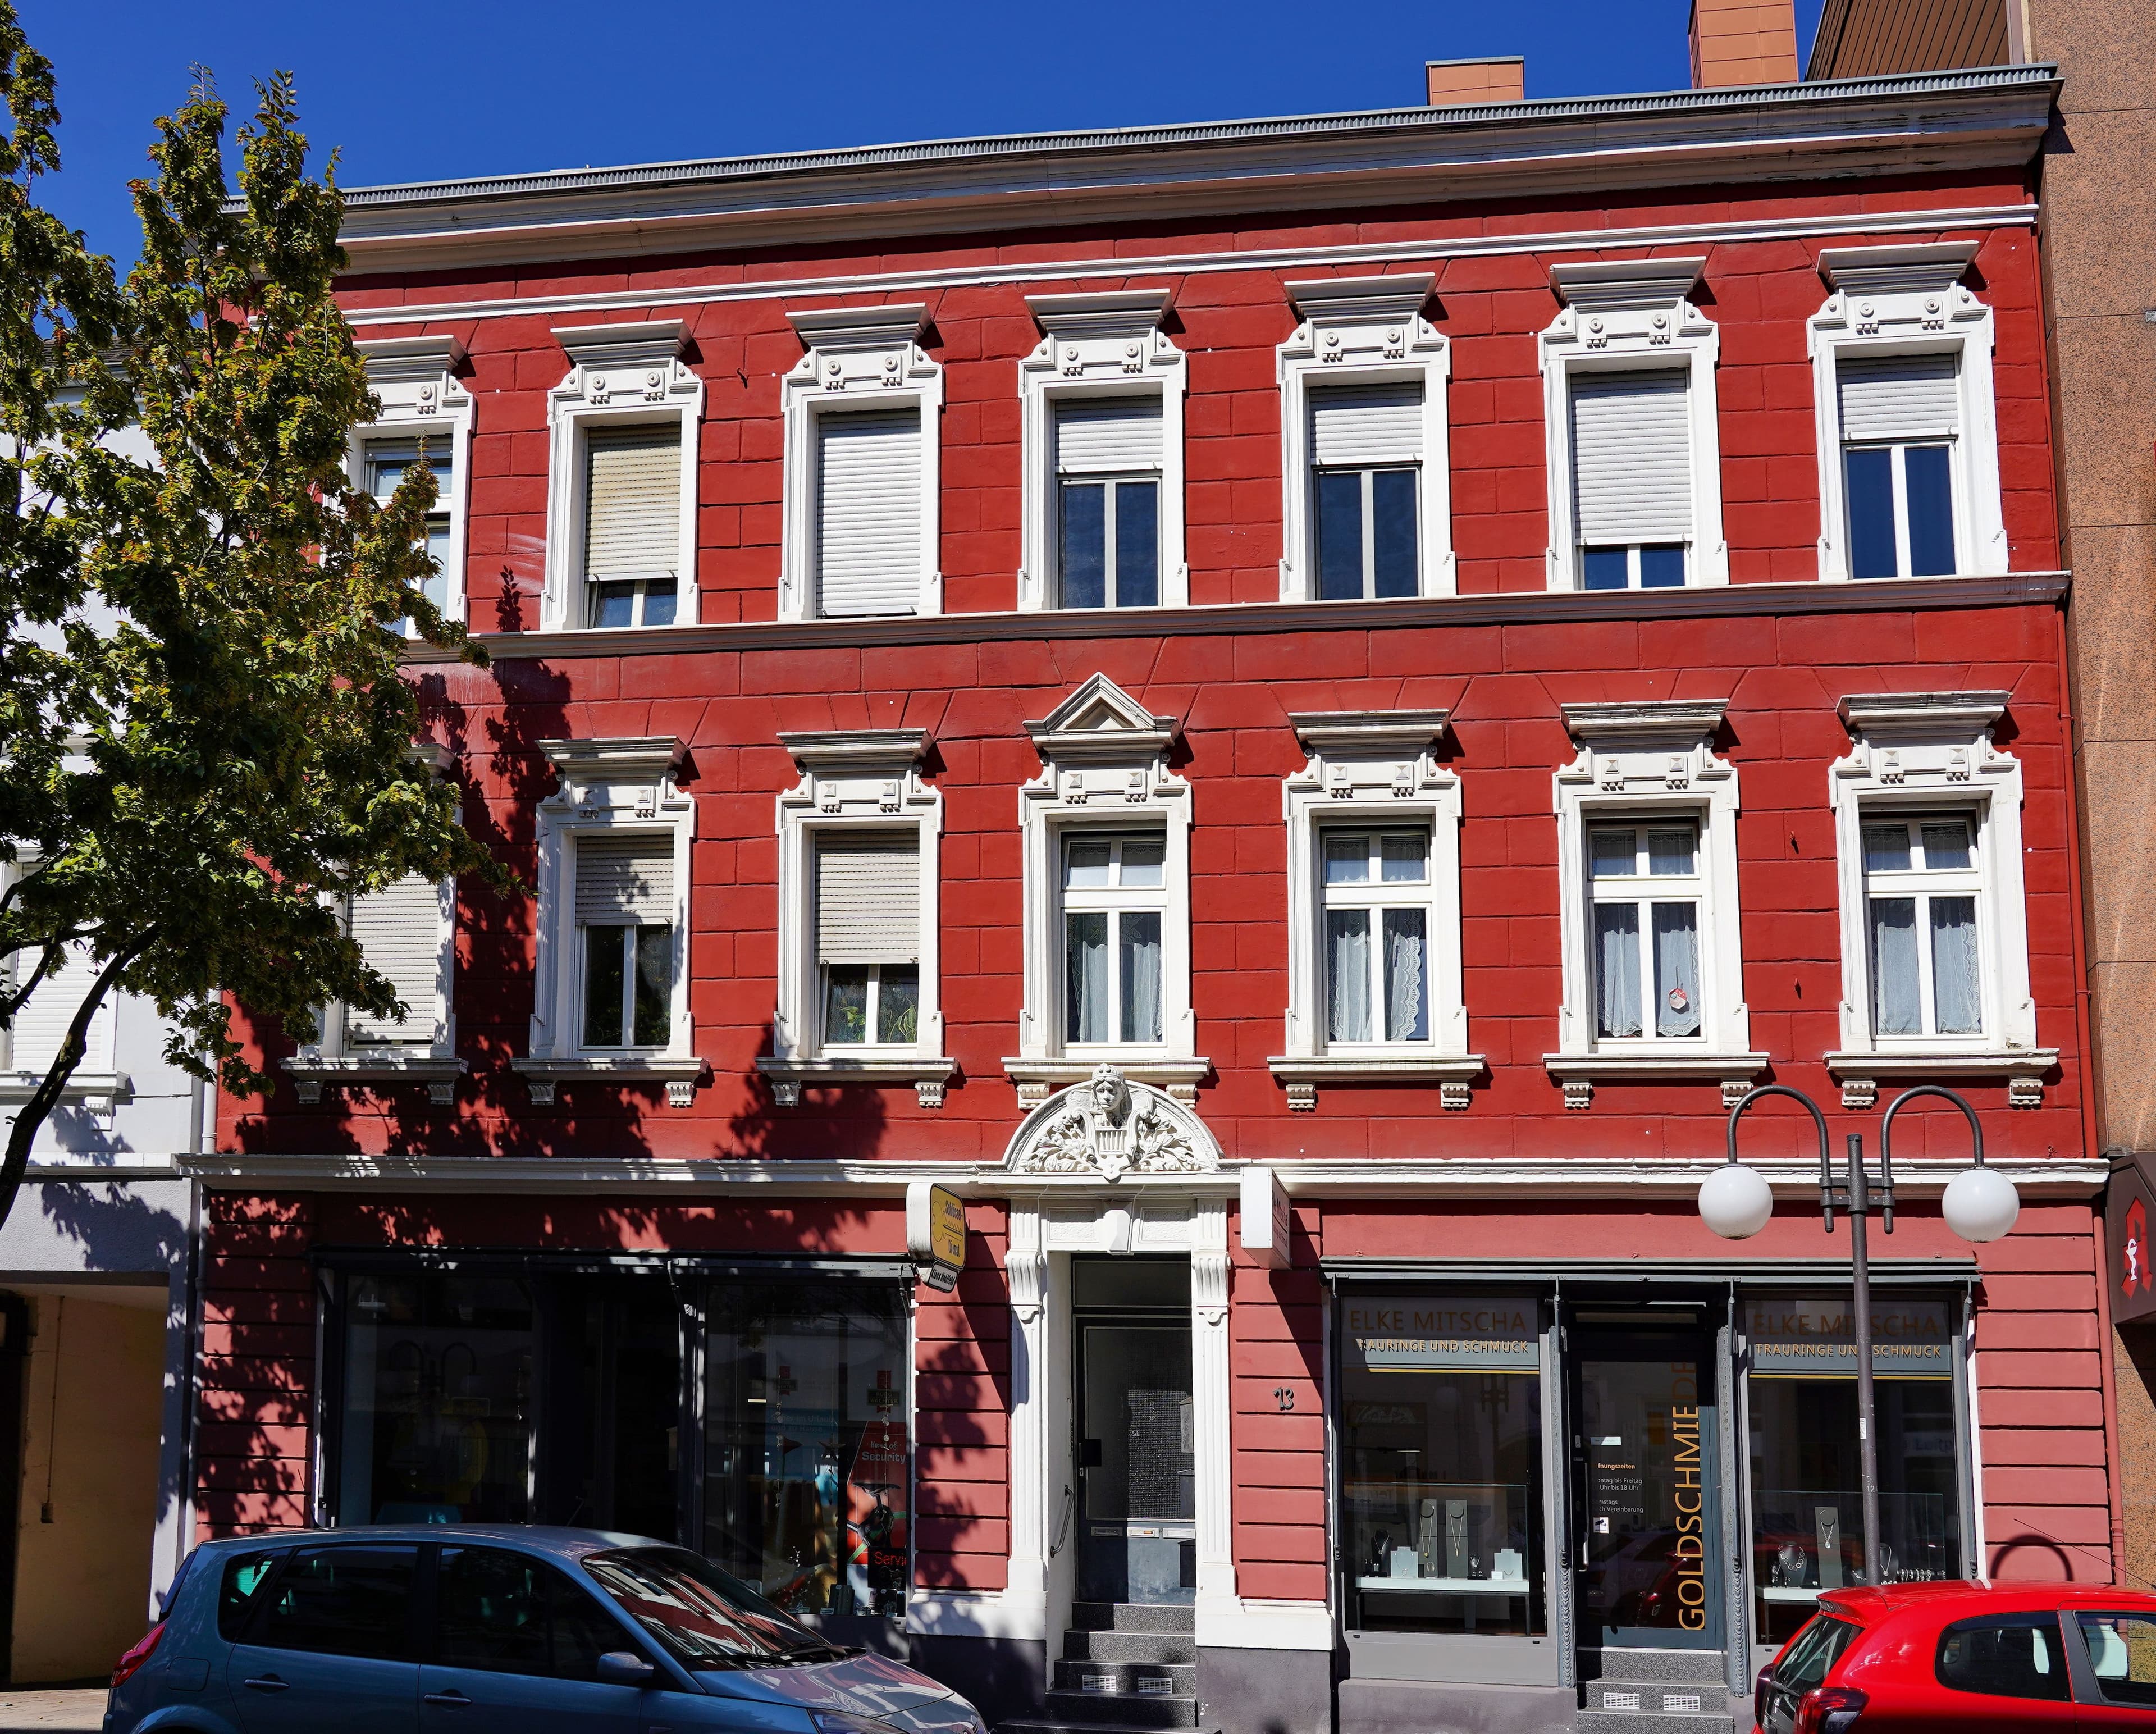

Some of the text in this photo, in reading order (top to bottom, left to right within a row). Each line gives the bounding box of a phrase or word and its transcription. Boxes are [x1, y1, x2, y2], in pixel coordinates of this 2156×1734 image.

[945, 1199, 963, 1221] Schlüssel-
[948, 1239, 960, 1257] Dienst
[931, 1268, 942, 1281] Klaus
[1350, 1310, 1527, 1332] ELKE MITSCHA
[1754, 1314, 1940, 1337] ELKE MISCHA
[1431, 1340, 1459, 1351] UND
[1463, 1340, 1527, 1351] SCHMUCK
[1756, 1343, 1941, 1356] TRAURINGE UN SCHMUCK
[1273, 1388, 1294, 1410] 13
[889, 1441, 898, 1451] of
[862, 1451, 906, 1464] Security
[1671, 1362, 1706, 1630] GOLDSCHMIEDE
